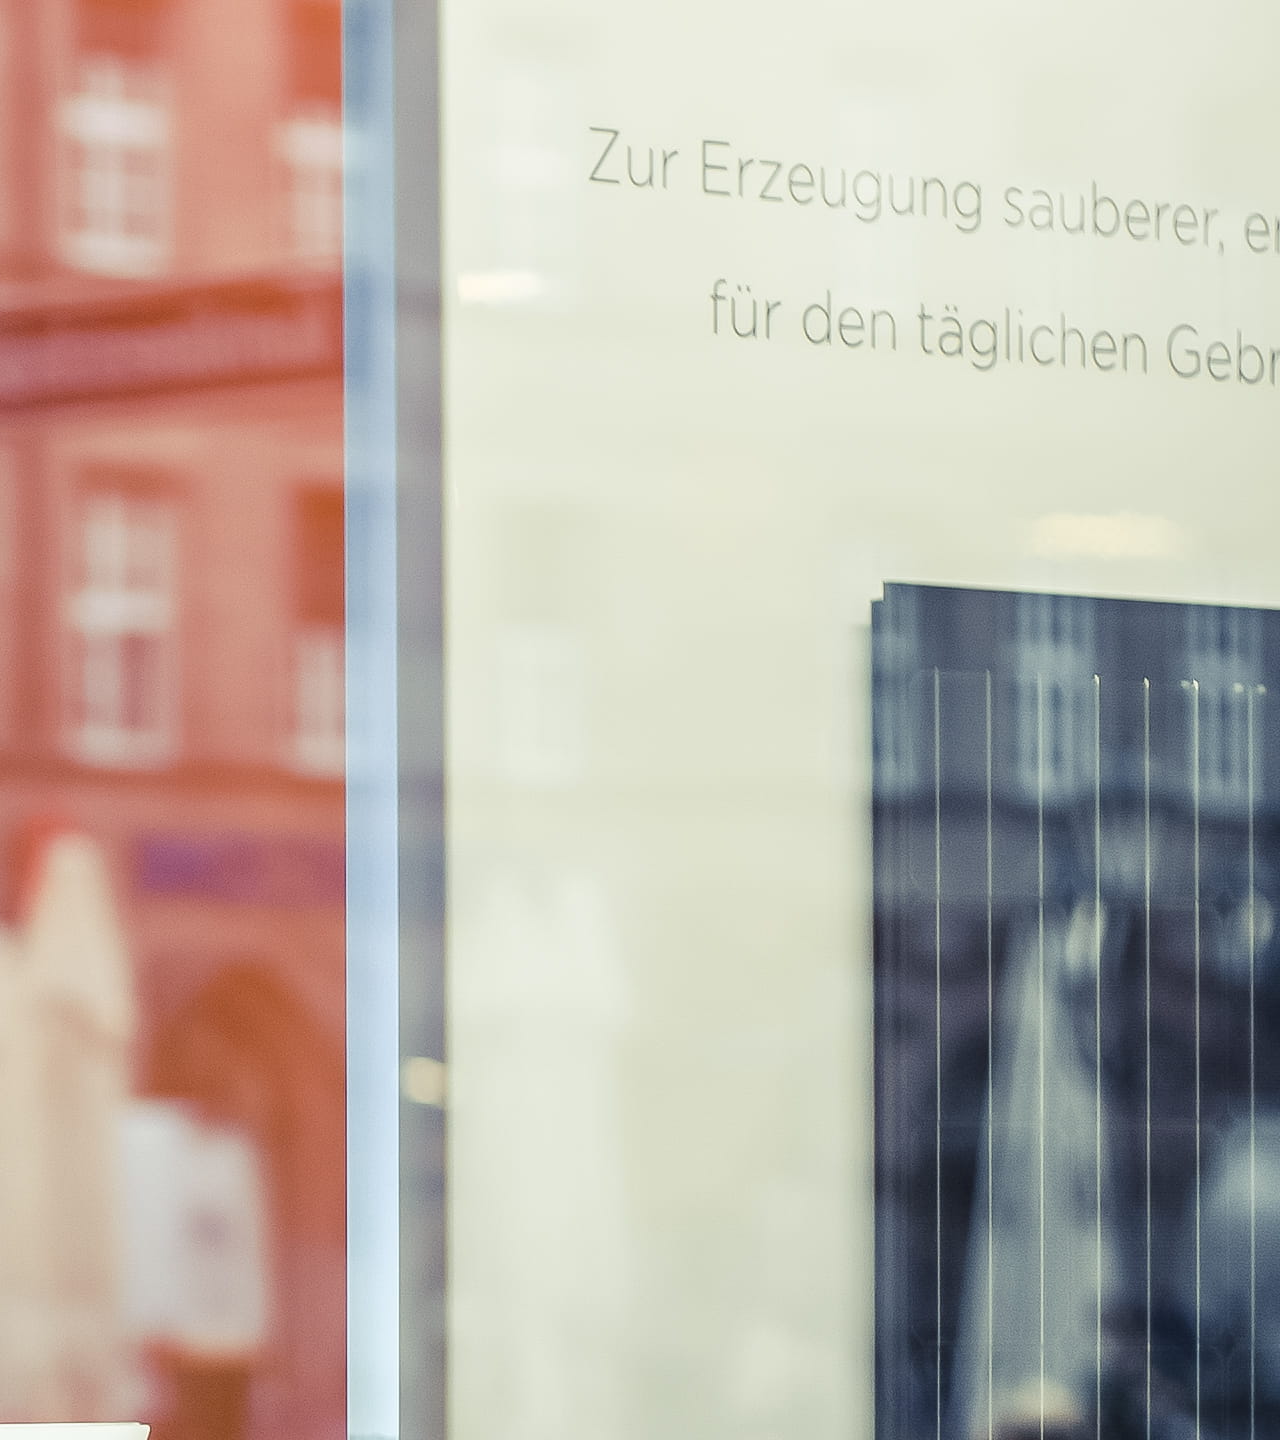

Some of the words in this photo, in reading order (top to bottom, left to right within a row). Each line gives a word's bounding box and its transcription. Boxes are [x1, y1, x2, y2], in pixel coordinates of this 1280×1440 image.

[588, 126, 679, 188] Zur
[701, 139, 984, 233] Erzeugung
[1002, 180, 1225, 256] sauberer,
[709, 277, 782, 341] für
[801, 290, 897, 351] den
[916, 300, 1149, 376] täglichen
